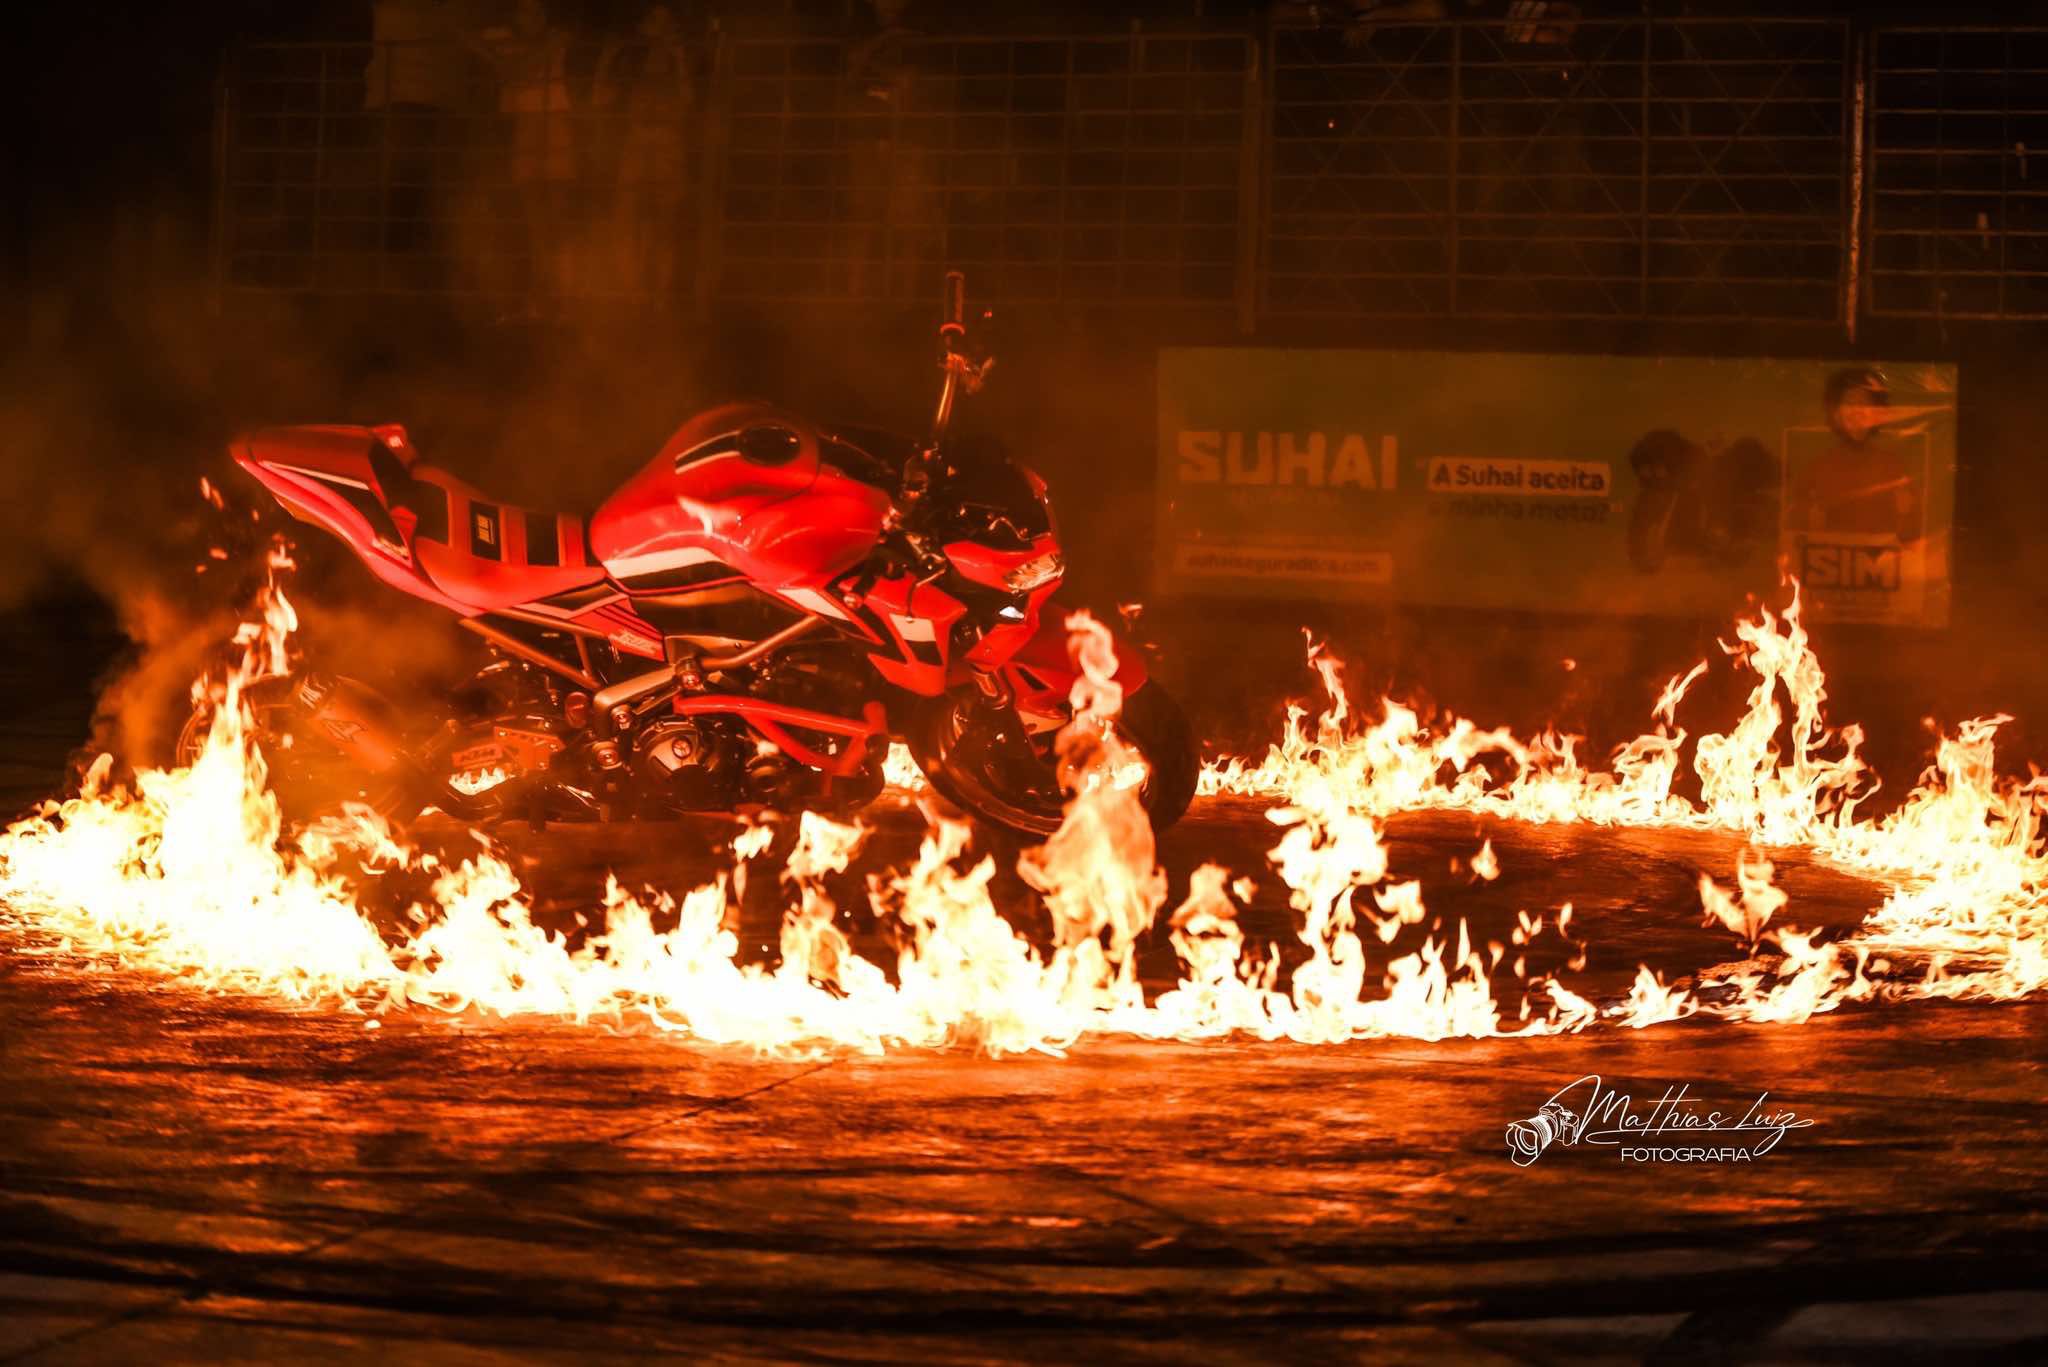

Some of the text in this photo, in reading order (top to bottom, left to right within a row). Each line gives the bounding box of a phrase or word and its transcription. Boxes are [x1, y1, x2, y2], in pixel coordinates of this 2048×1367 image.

[1178, 430, 1399, 488] SUHAI
[1431, 464, 1605, 491] A Suhai aceita
[1806, 544, 1897, 587] SIM
